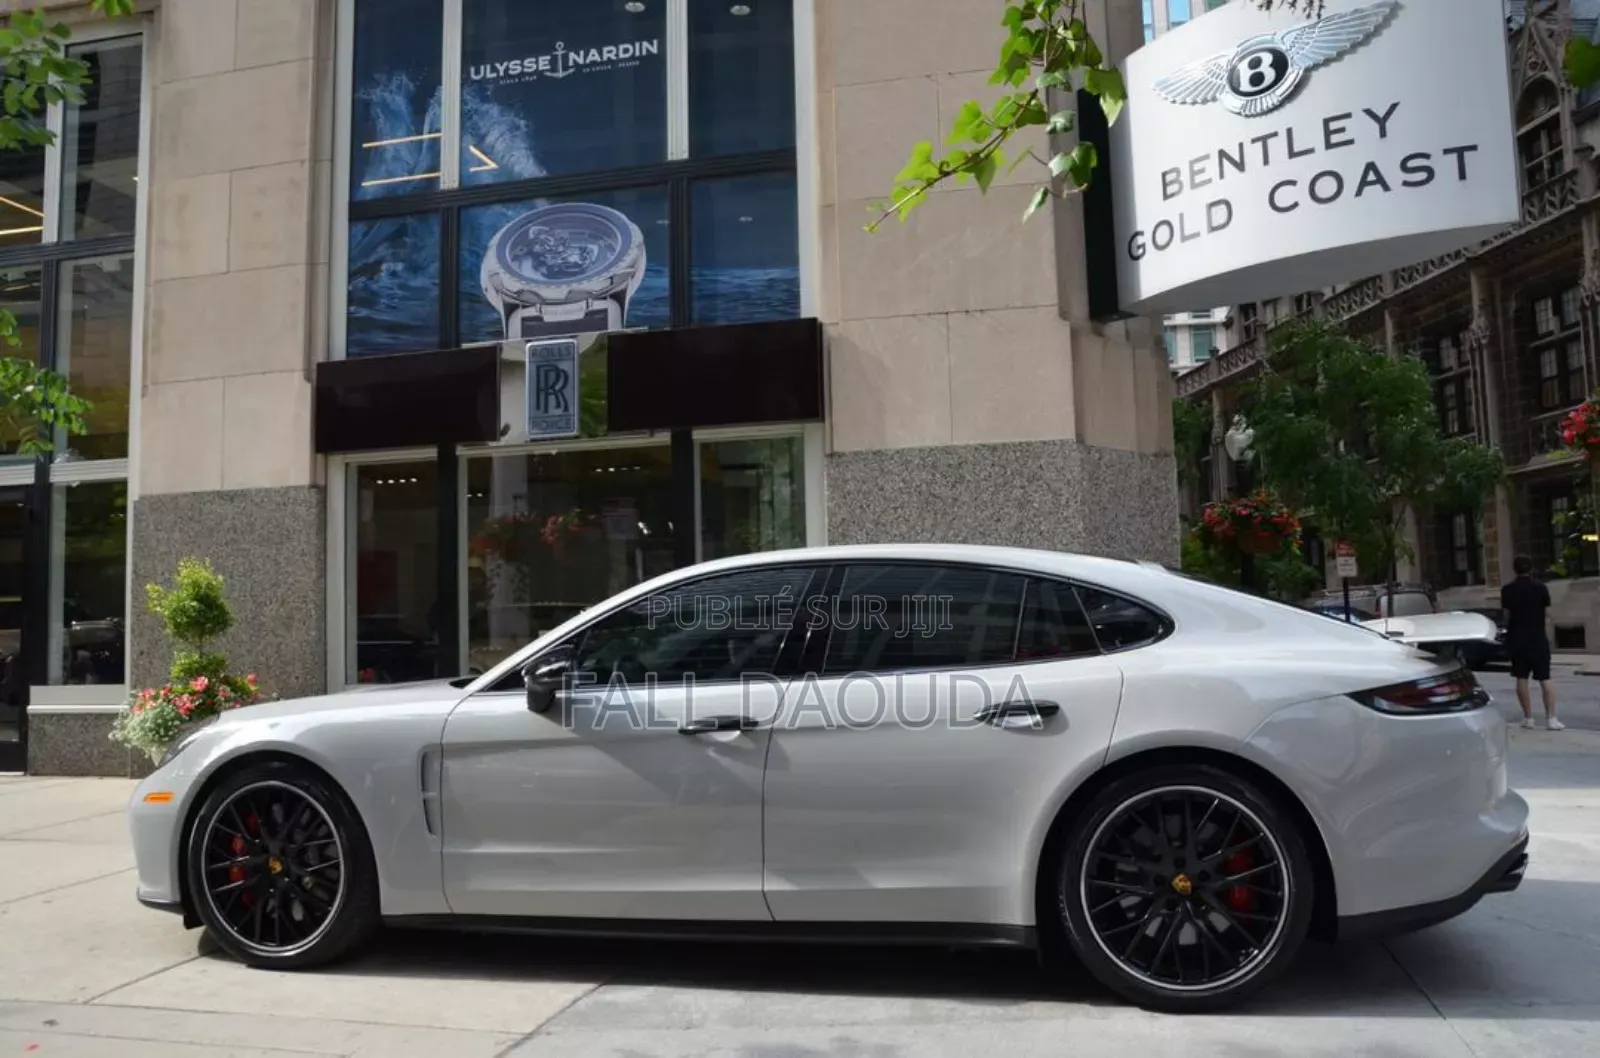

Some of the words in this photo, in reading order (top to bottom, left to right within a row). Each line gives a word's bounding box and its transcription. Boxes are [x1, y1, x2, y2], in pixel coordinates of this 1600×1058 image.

[470, 55, 551, 80] ULYSSE
[568, 39, 659, 66] NARDIN
[1161, 101, 1400, 202] BENTLEY
[1127, 197, 1234, 262] GOLD
[1268, 144, 1479, 213] COAST
